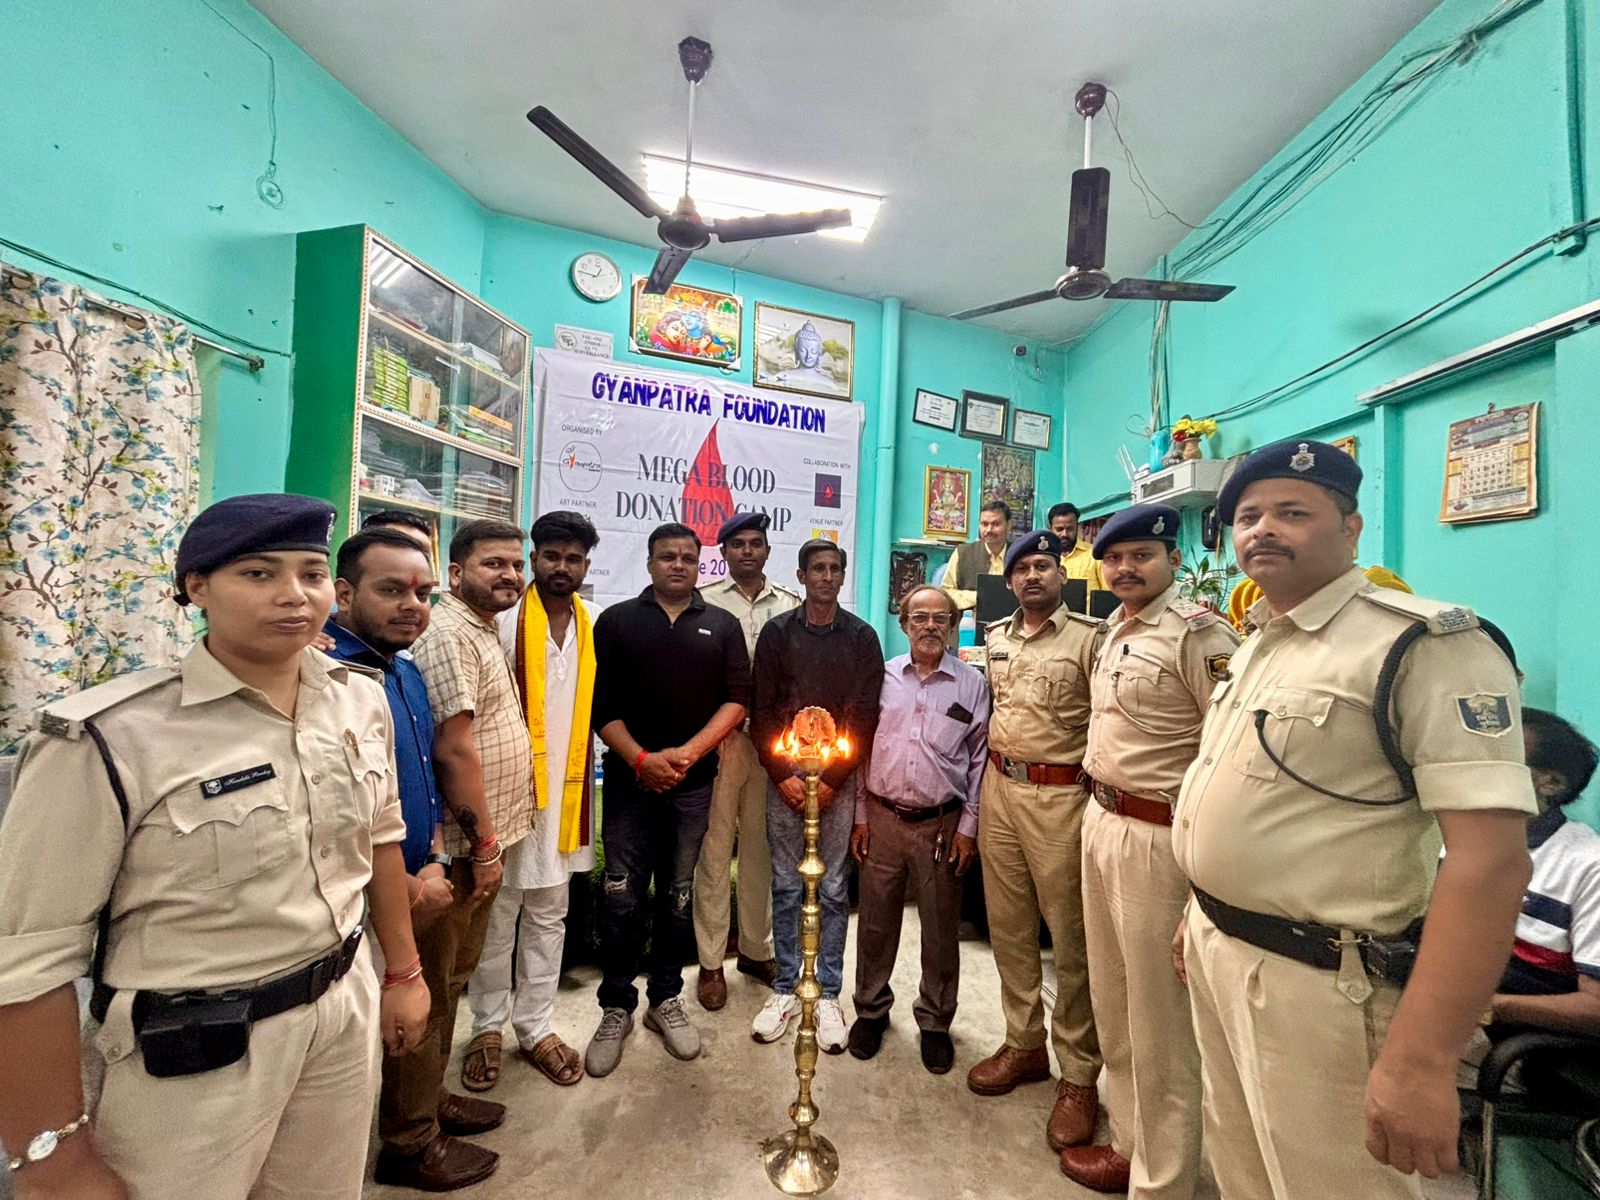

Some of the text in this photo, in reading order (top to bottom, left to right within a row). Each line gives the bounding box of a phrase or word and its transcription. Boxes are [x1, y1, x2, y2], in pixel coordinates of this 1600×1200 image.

[592, 372, 826, 433] GYANPATRA FOUNDATION
[561, 424, 594, 435] ORGANISED
[803, 457, 838, 469] COLLABORATION
[637, 453, 776, 494] MEGA BLOOD
[560, 498, 597, 508] ART PARTNER
[615, 491, 731, 526] DONATION
[809, 517, 843, 526] VENUE PARTNER
[589, 568, 610, 576] ARTNER
